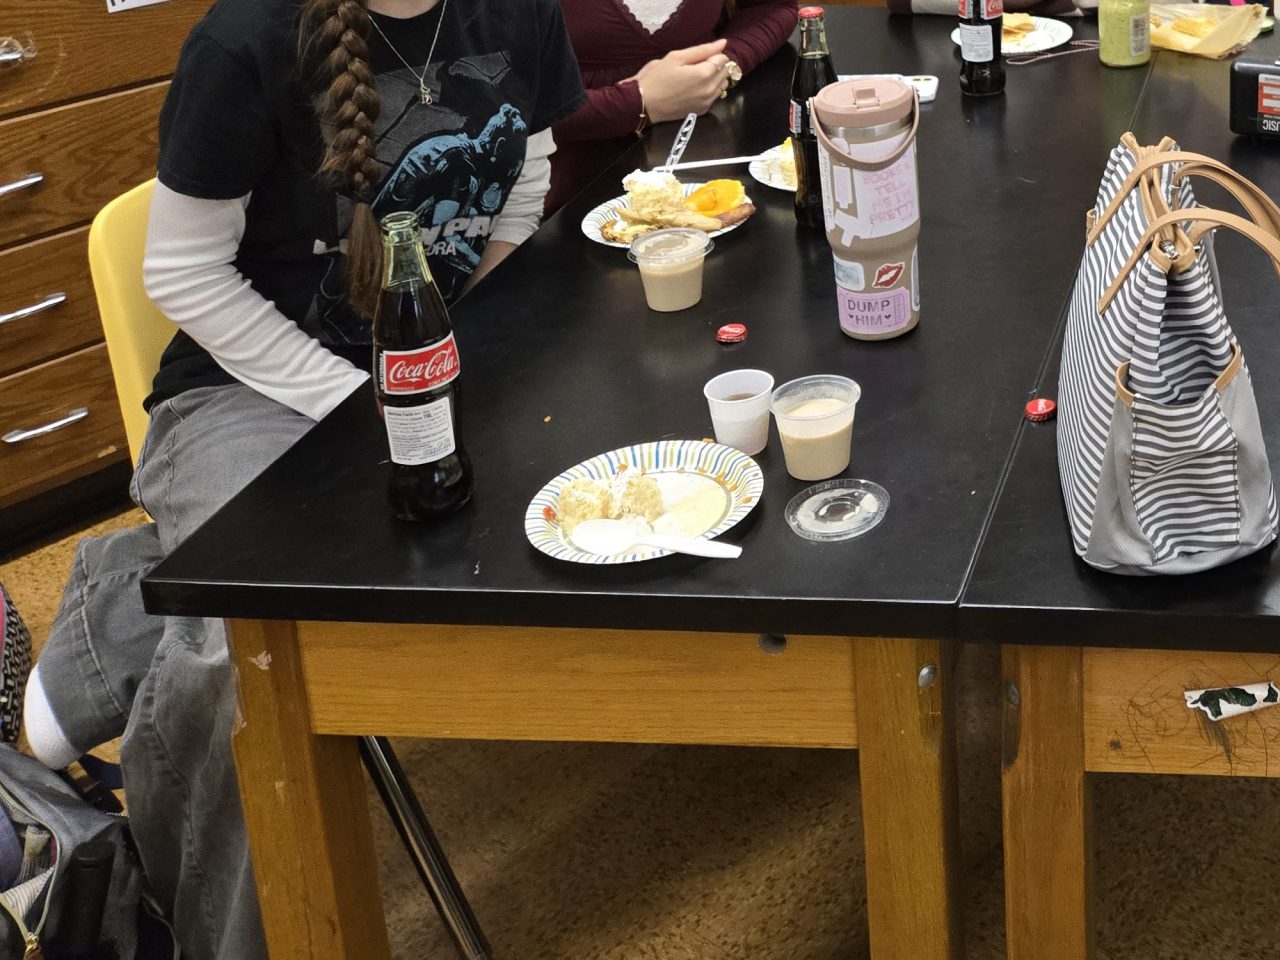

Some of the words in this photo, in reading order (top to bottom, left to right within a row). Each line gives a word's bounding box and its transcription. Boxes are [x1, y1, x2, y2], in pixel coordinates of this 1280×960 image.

[848, 299, 890, 312] DUMP
[856, 314, 883, 326] HIM
[389, 345, 457, 384] Coca-Cola
